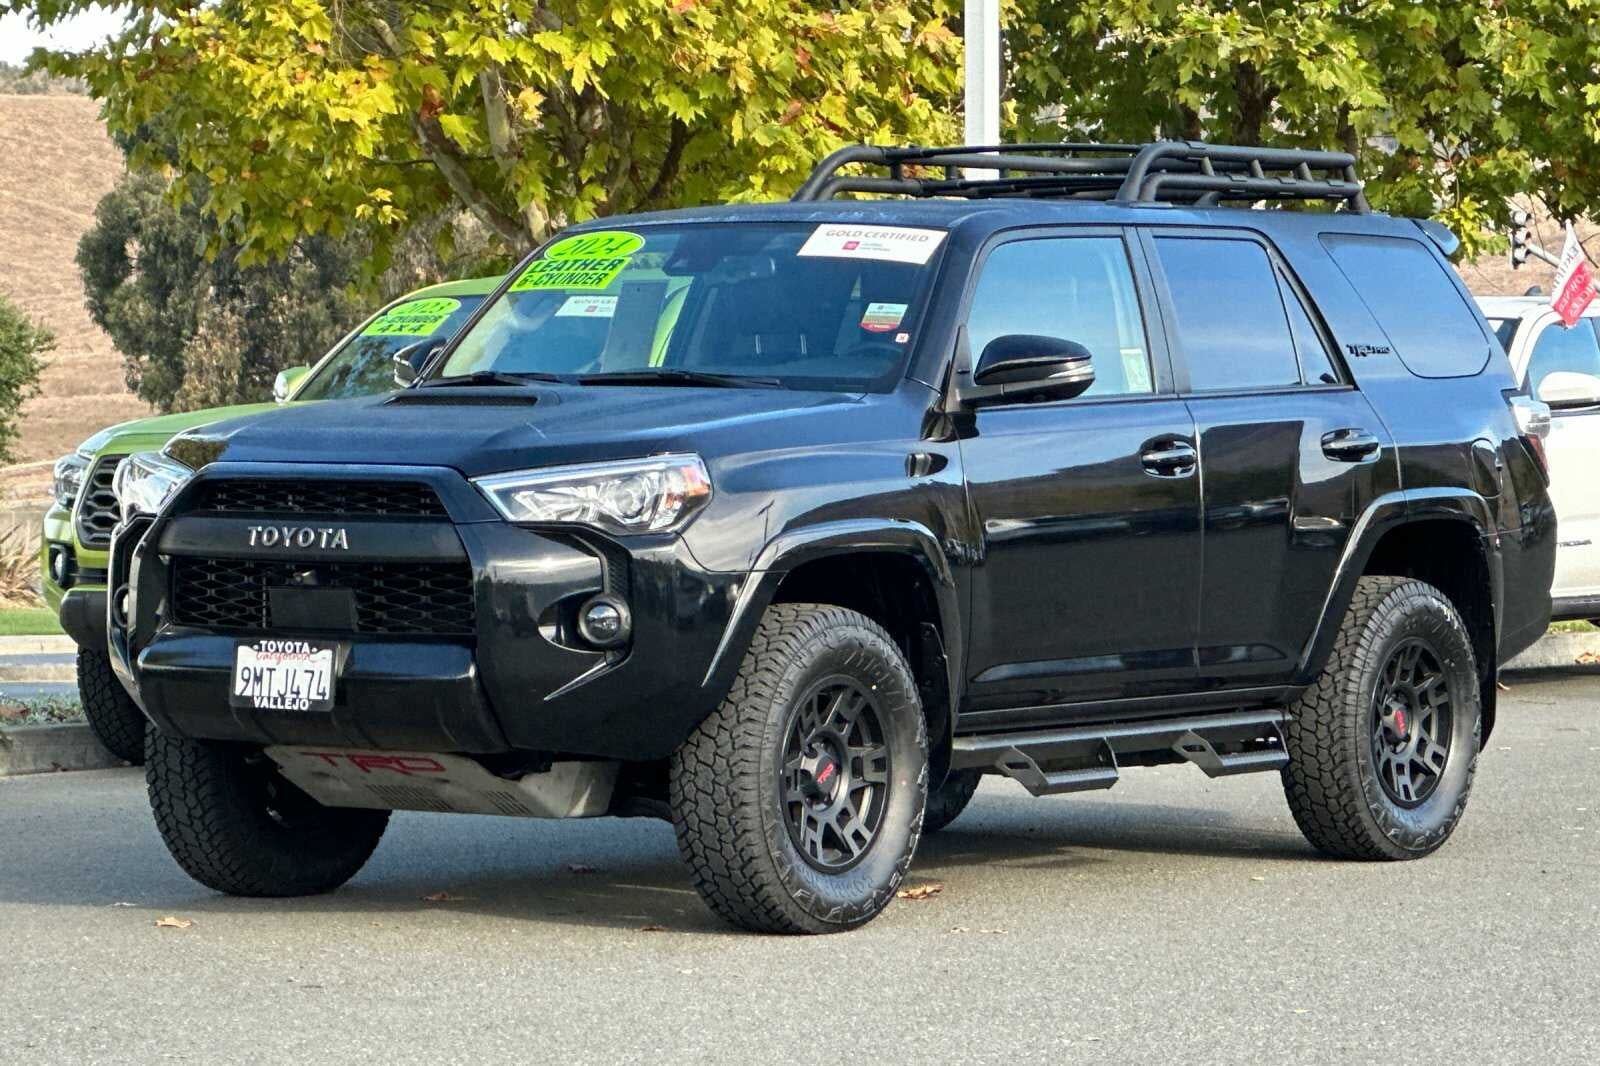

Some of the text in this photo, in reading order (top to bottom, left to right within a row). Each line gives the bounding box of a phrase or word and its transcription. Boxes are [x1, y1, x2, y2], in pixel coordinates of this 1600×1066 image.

[825, 229, 929, 242] GOLD CERTIFIED
[553, 237, 634, 257] 2024
[527, 257, 625, 274] LEATHER
[516, 271, 609, 288] 6-CYLINDER
[248, 525, 349, 550] TOYOTA
[259, 640, 311, 653] TOYOTA
[241, 665, 328, 700] 9MTJ474
[253, 695, 311, 711] VALLEJO
[300, 751, 447, 776] TRD
